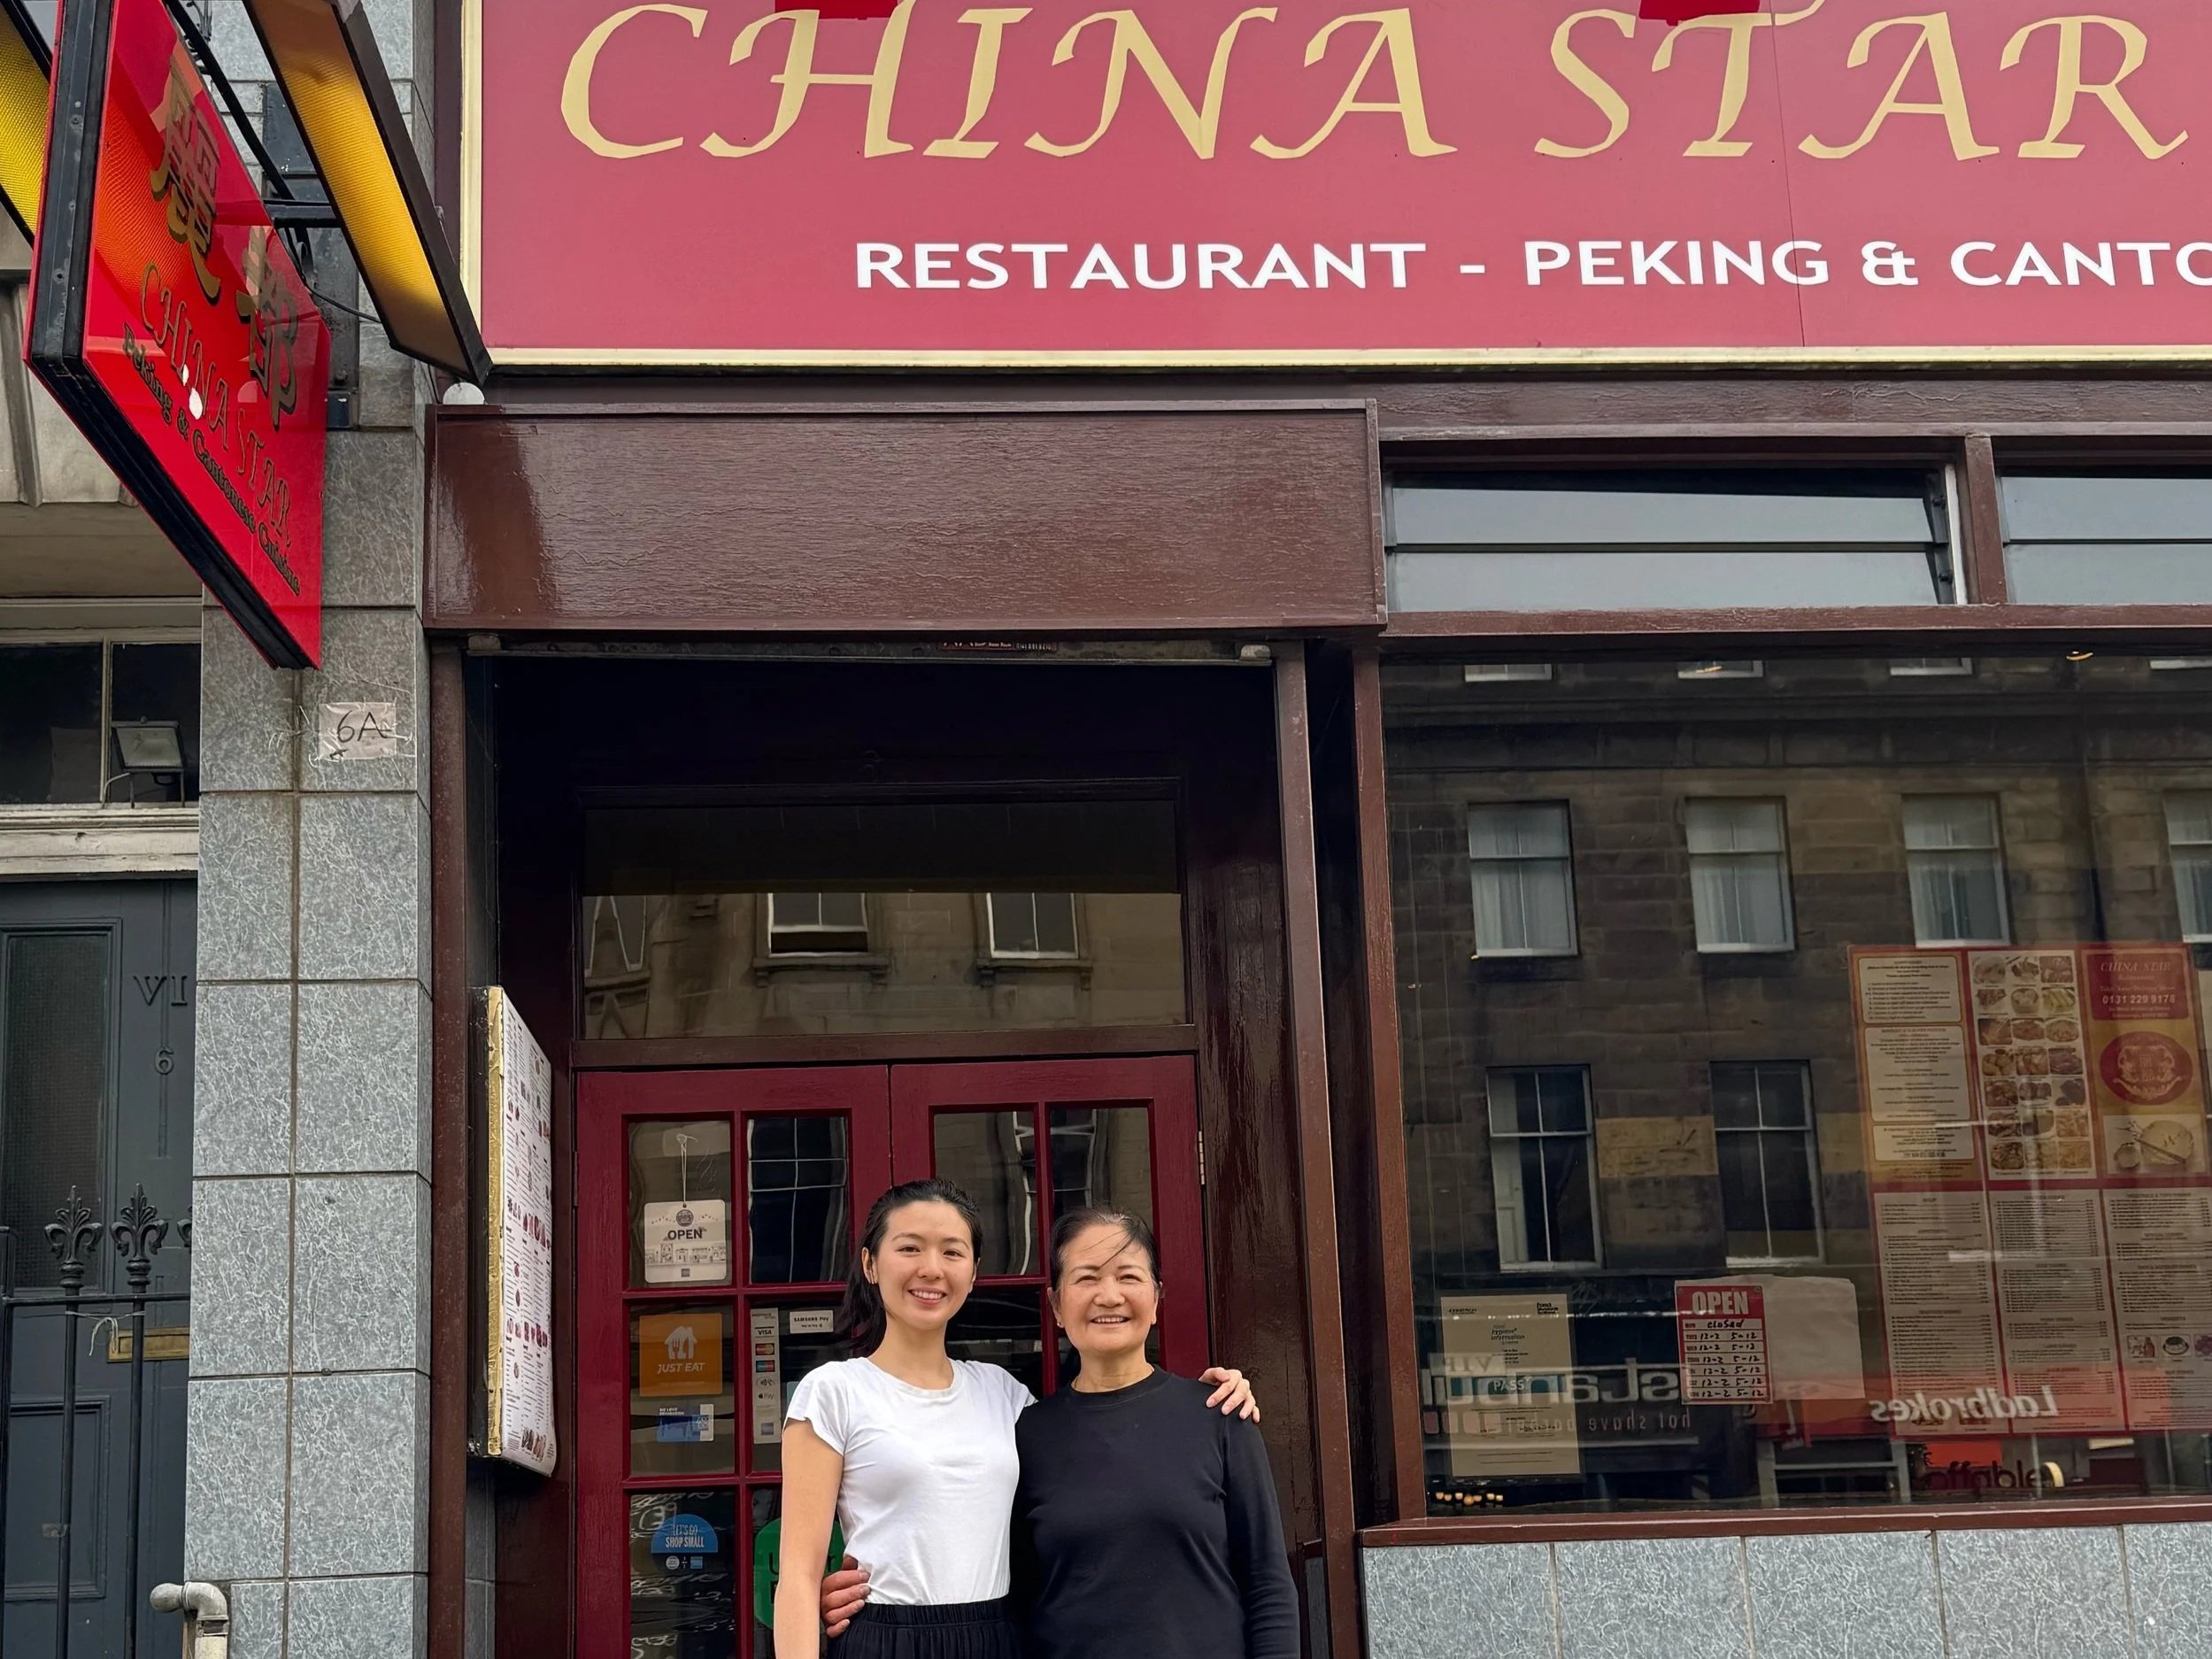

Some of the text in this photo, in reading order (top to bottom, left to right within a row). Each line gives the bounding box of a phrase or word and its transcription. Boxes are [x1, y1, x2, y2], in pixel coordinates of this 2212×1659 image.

[561, 0, 2189, 160] CHINA STAR
[856, 243, 1427, 289] RESTAURANT
[1525, 240, 1830, 287] PEKING
[1861, 241, 1919, 287] &
[142, 262, 292, 548] CHINA STAR
[122, 322, 301, 597] Peking & Cantonese Cuisine
[337, 710, 392, 743] 6A
[134, 975, 189, 1007] VI
[154, 1046, 175, 1076] 6
[667, 1229, 703, 1240] OPEN
[1692, 1291, 1749, 1316] OPEN
[657, 1362, 705, 1374] JUST EAT
[665, 1536, 705, 1548] SHOP SMALL
[768, 1551, 836, 1575] Ur
